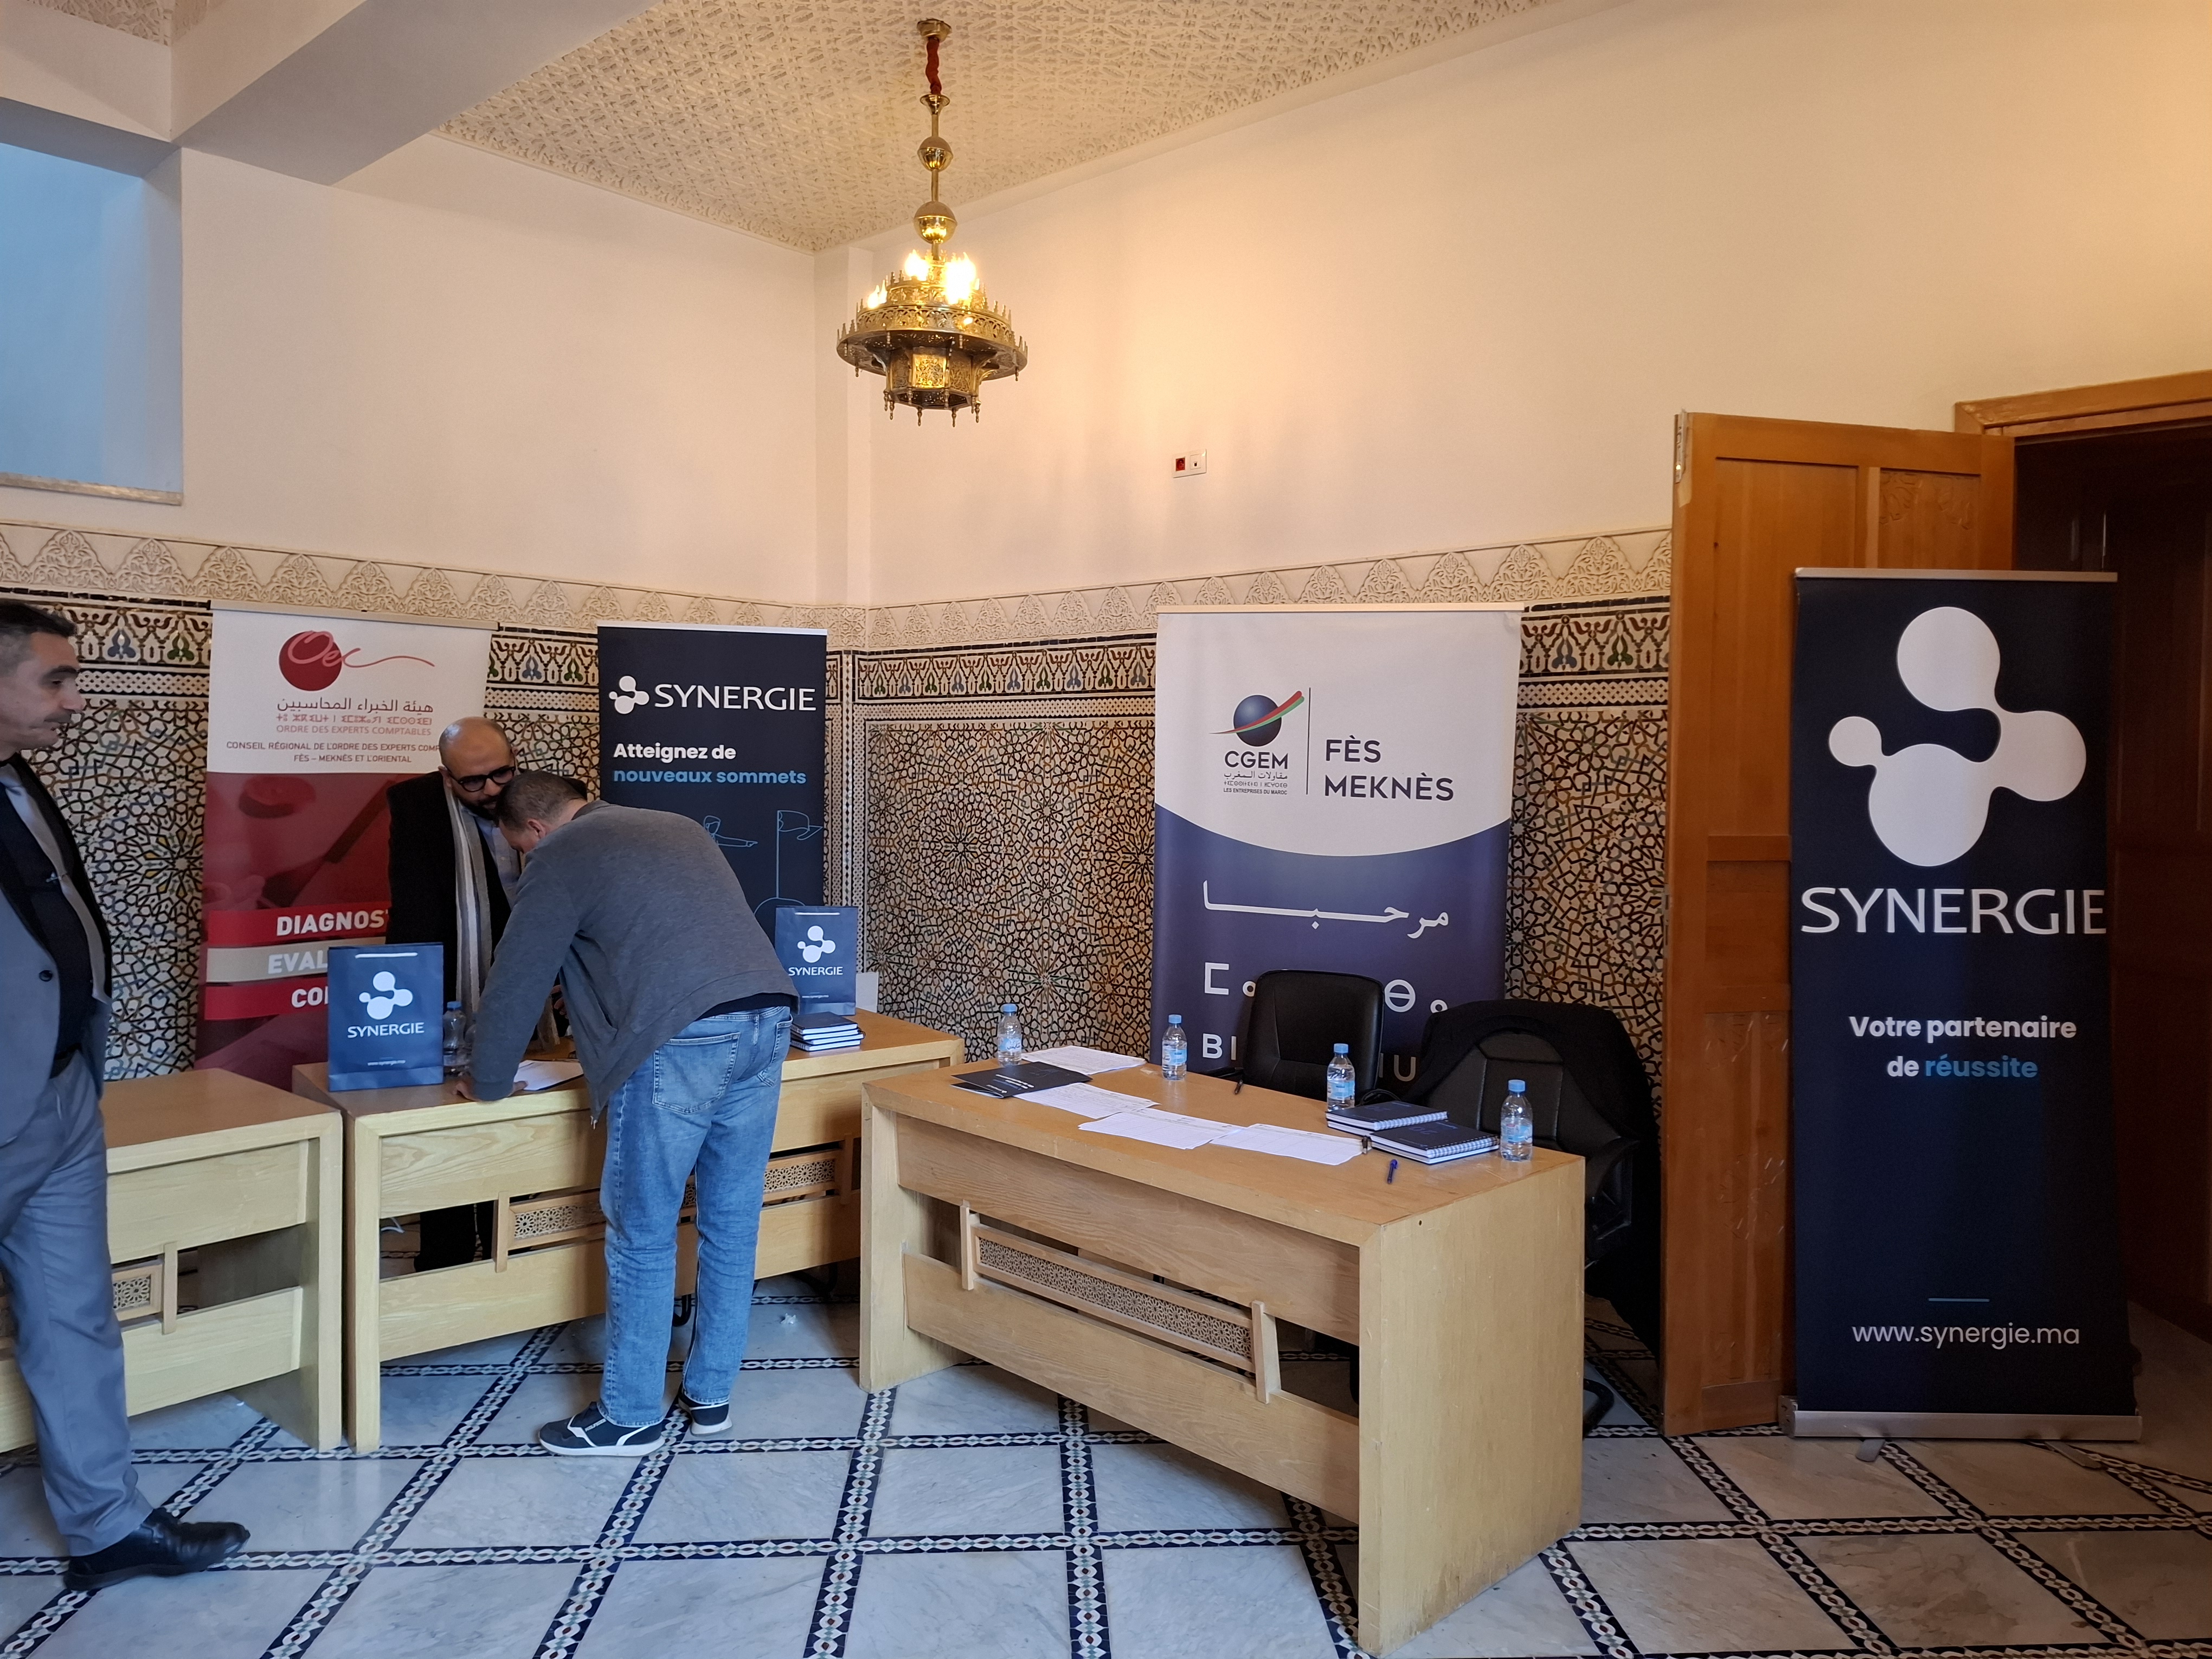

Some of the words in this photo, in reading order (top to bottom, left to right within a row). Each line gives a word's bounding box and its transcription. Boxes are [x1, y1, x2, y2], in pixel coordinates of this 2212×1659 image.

[278, 697, 351, 711] المحاسبين
[655, 684, 816, 710] SYNERGIE
[358, 698, 397, 713] الخبراء
[403, 701, 433, 715] هيئة
[276, 725, 308, 733] ORDRE
[372, 727, 431, 736] COMPTABLES
[227, 741, 266, 749] CONSEIL
[268, 742, 311, 750] RÉGIONAL
[614, 743, 708, 763] Atteignez
[712, 745, 736, 759] de
[1326, 735, 1380, 763] FÈS
[1225, 751, 1288, 769] CGEM
[614, 771, 712, 782] nouveaux
[717, 770, 806, 783] sommets
[1224, 771, 1255, 780] المغرب
[1258, 772, 1287, 781] مقاولات
[1325, 773, 1454, 801] MEKNÈS
[1204, 880, 1448, 938] مرحبا
[1801, 888, 2106, 934] SYNERGIE
[788, 967, 843, 976] SYNERGIE
[348, 1023, 425, 1038] SYNERGIE
[1849, 1017, 1921, 1037] Votre
[1927, 1015, 2076, 1043] partenaire
[1887, 1056, 1919, 1077] de
[1924, 1053, 2037, 1077] réussite
[1852, 1322, 2079, 1349] www.synergie.ma
